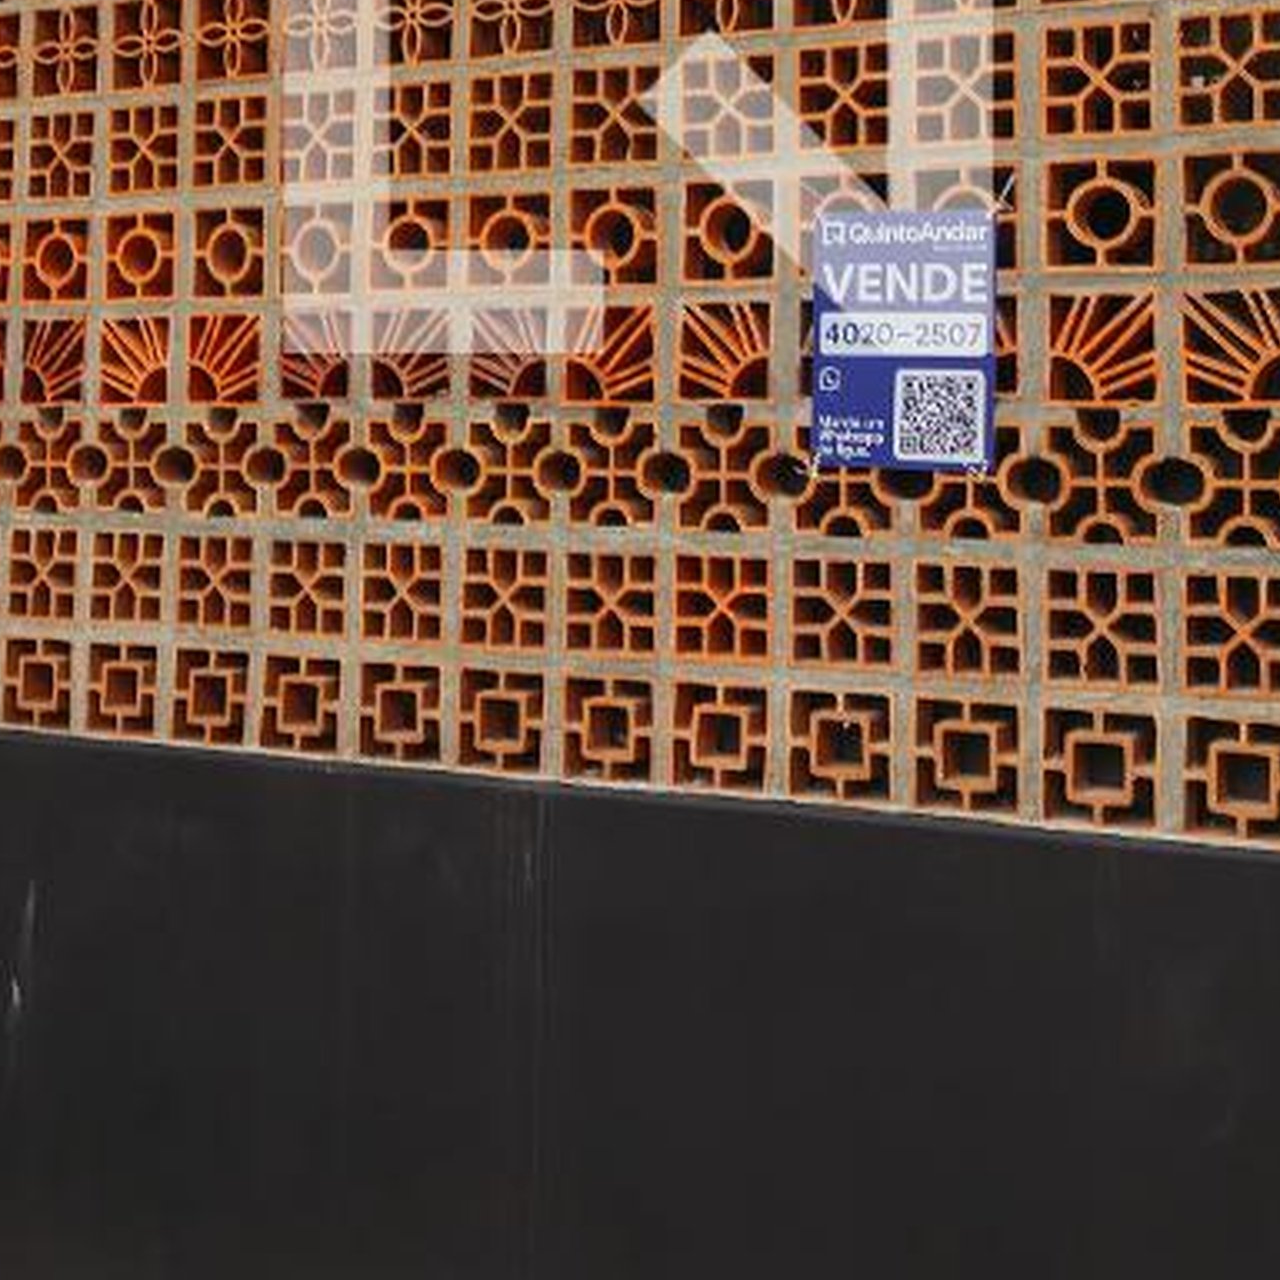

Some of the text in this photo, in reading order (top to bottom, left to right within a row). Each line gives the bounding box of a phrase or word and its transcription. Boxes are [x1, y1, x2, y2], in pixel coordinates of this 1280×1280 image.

[849, 220, 988, 244] QuintoAndar
[822, 262, 989, 304] VENDE
[825, 321, 982, 347] 4020-2507
